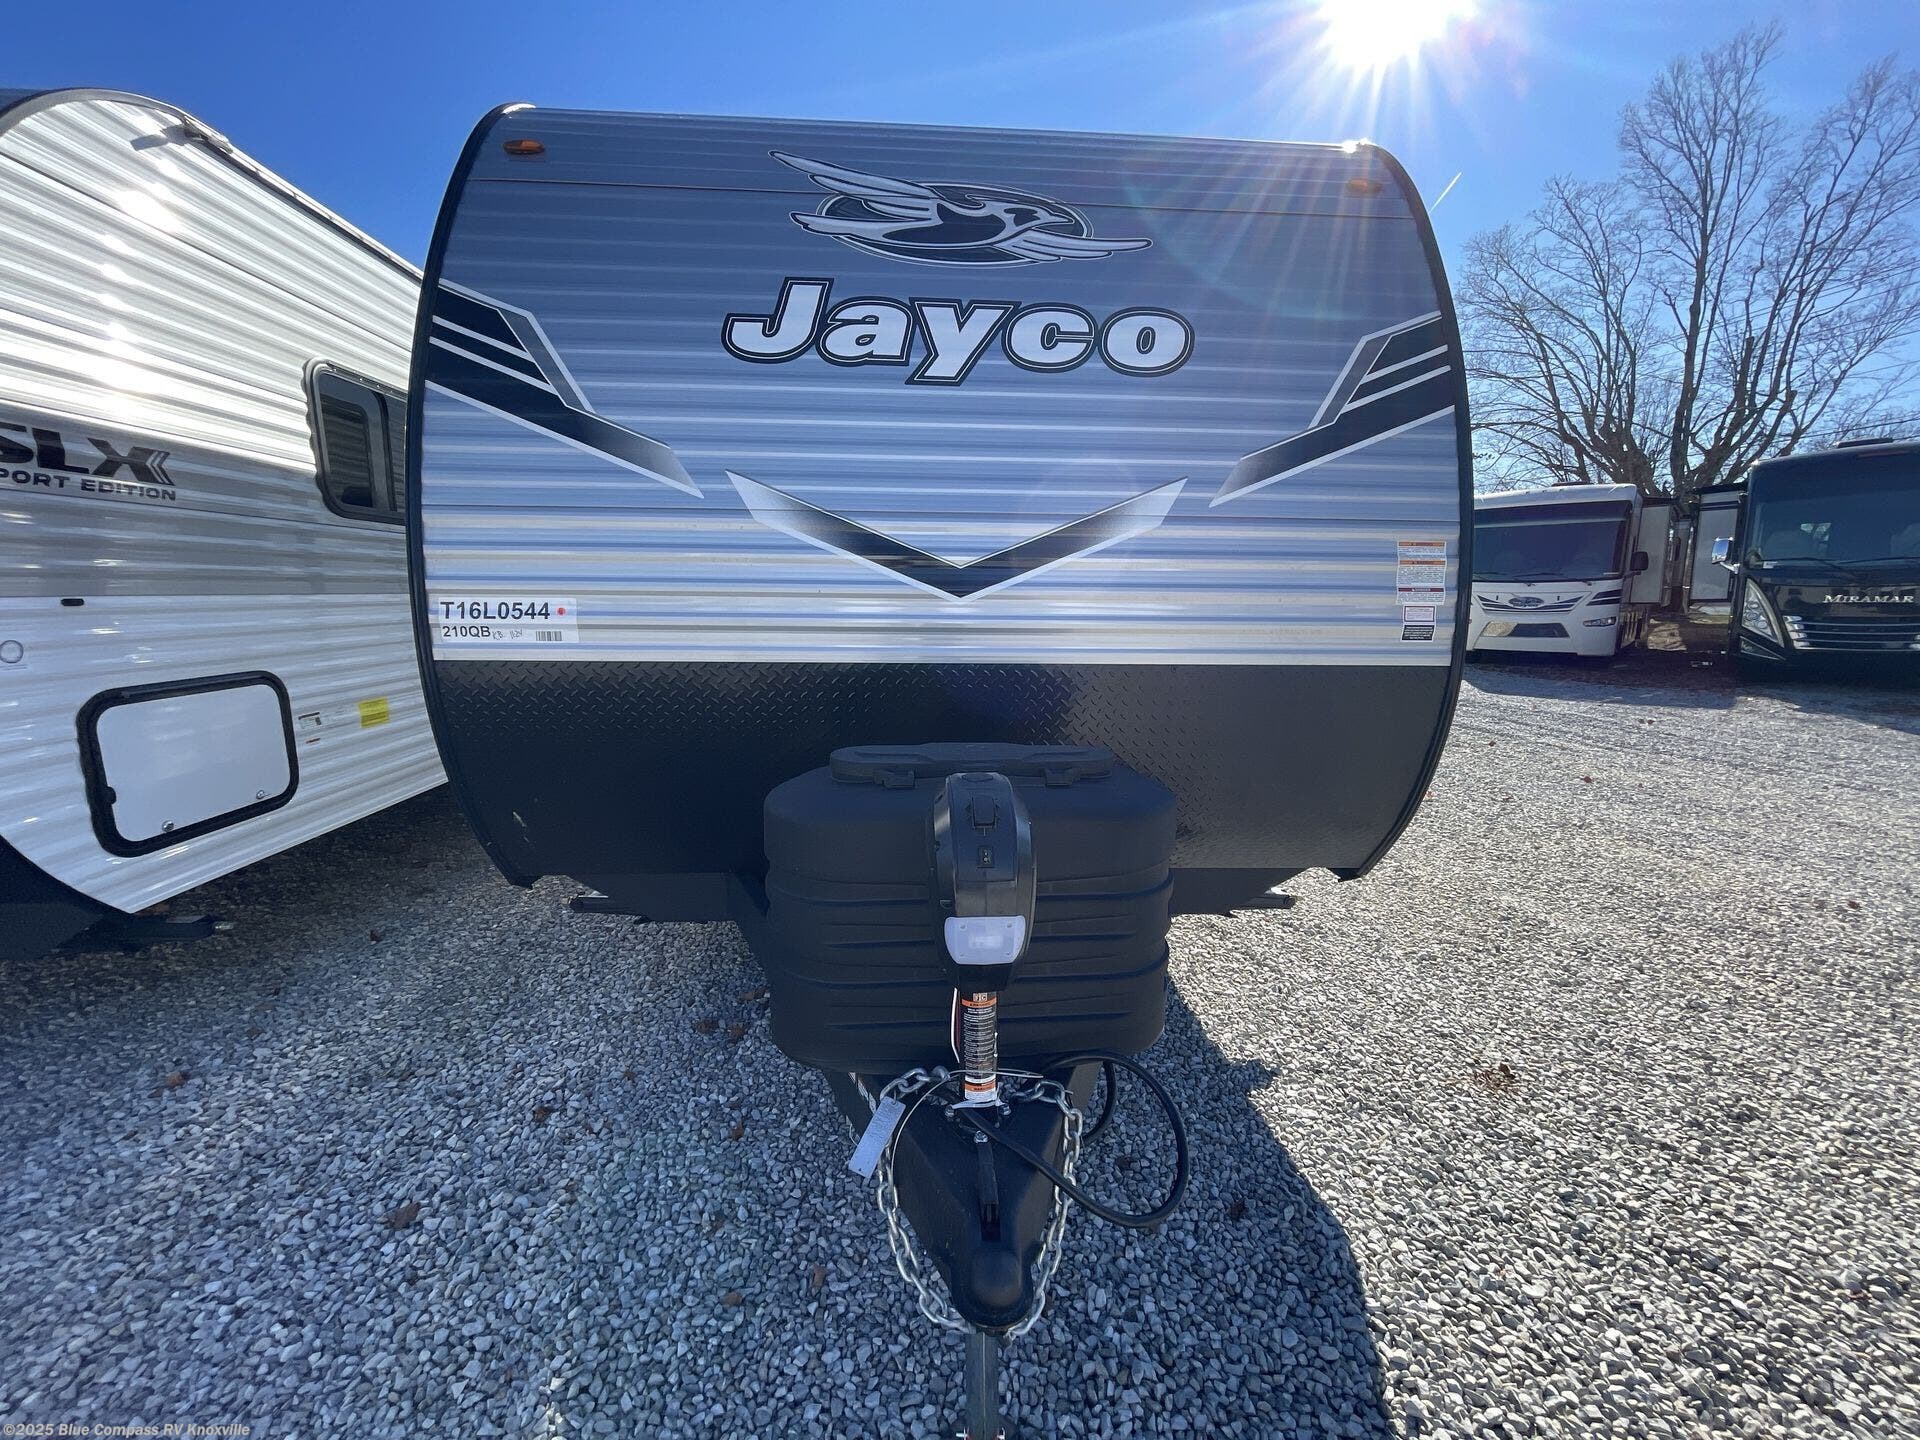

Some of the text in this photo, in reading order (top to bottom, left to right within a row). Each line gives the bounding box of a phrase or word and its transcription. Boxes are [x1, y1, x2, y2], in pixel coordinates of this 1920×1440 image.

[721, 276, 1196, 387] Jayco
[81, 478, 176, 501] EDITION
[1822, 594, 1914, 604] MIRAMAR
[440, 601, 550, 620] T16L0544
[442, 625, 491, 638] 210QB
